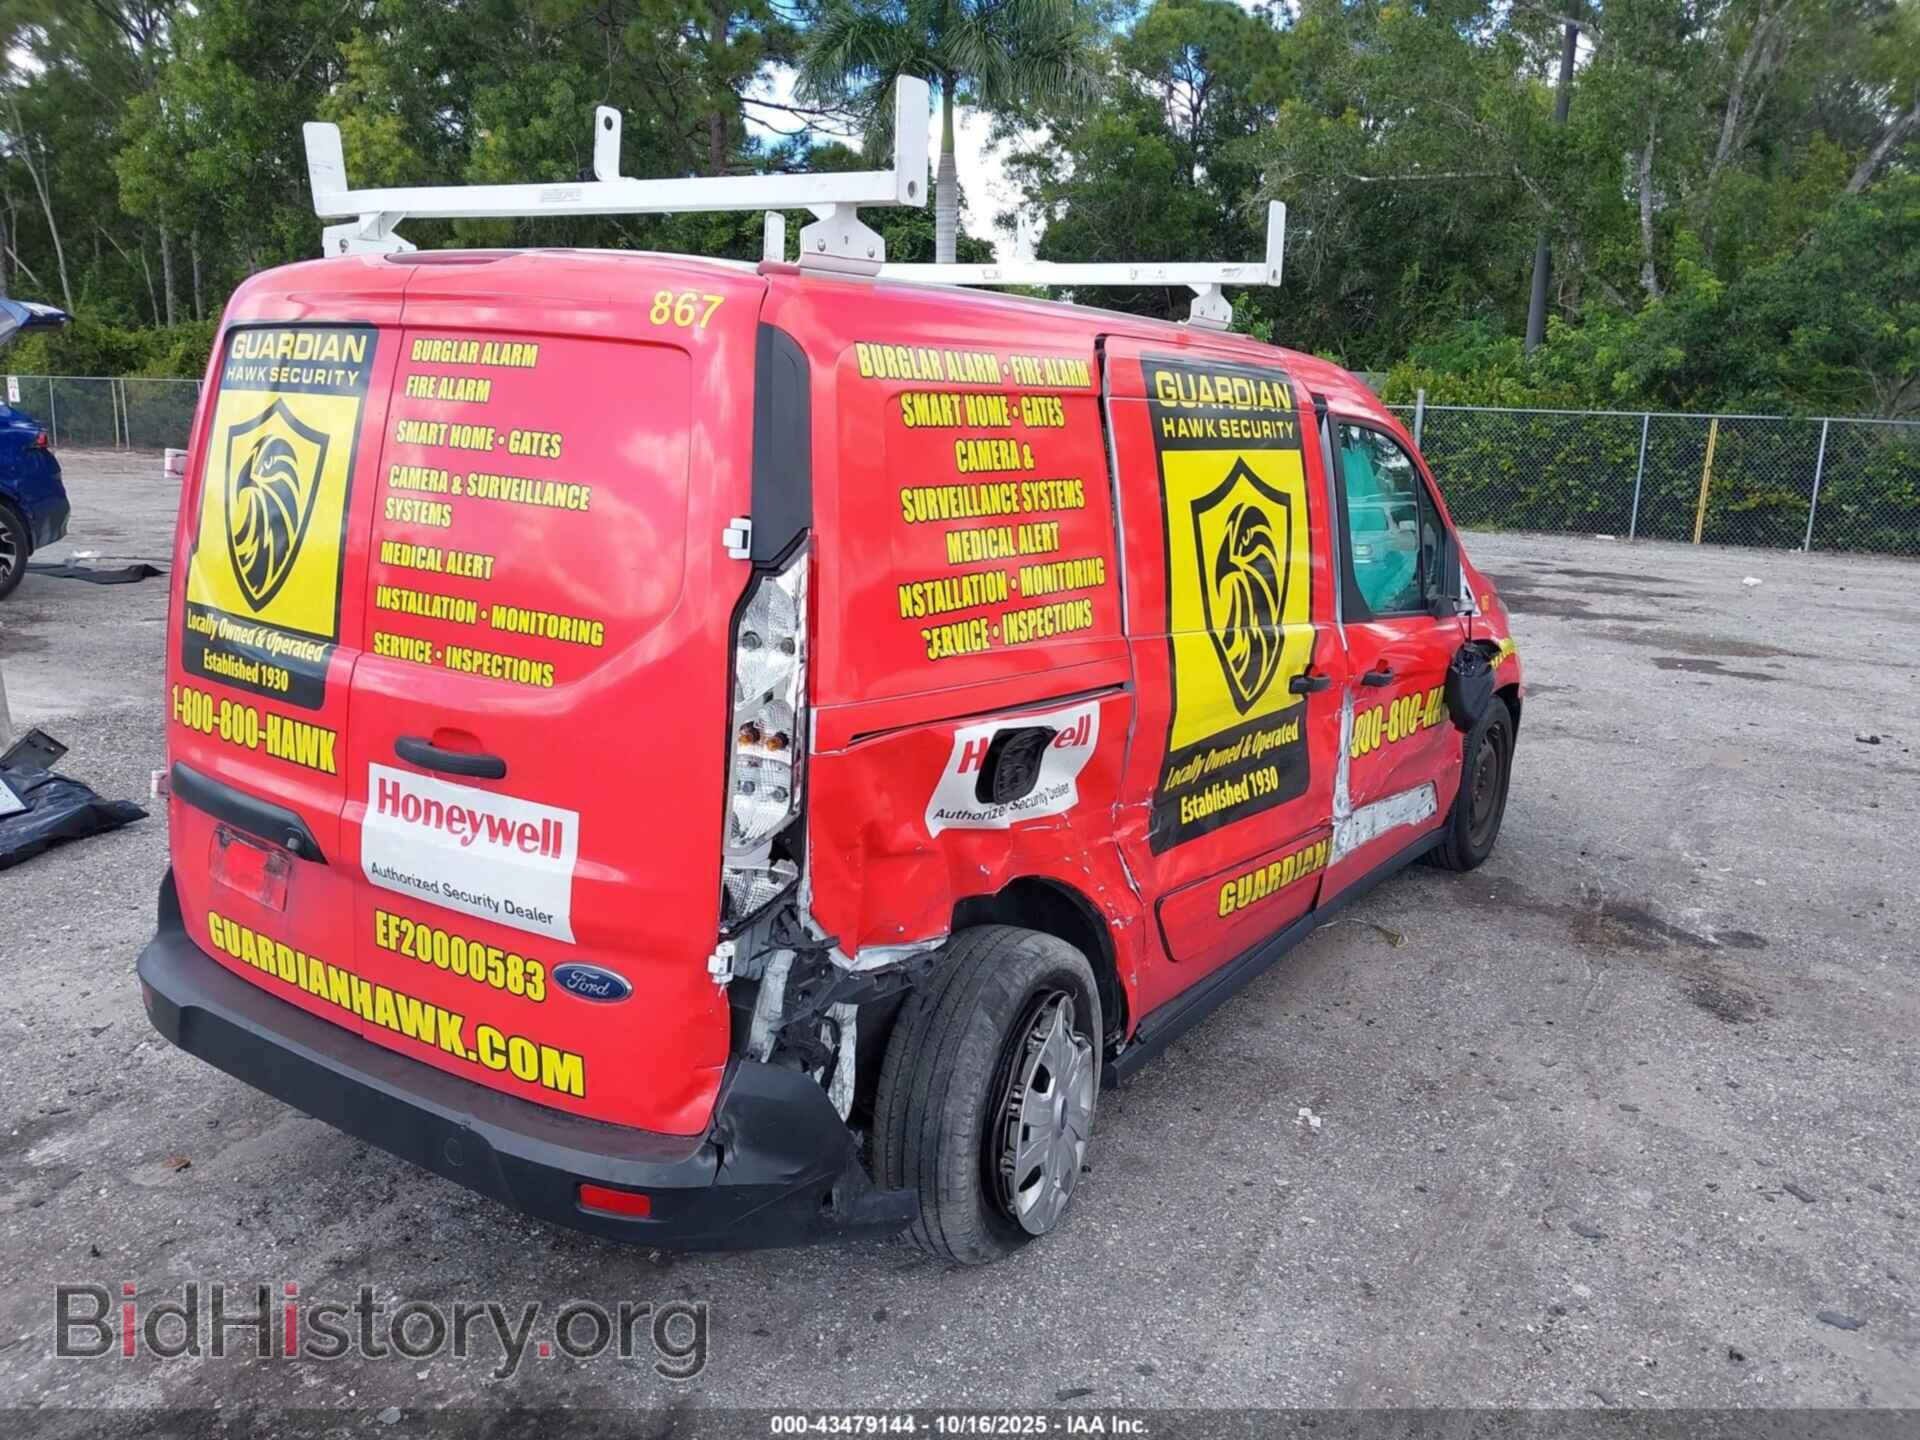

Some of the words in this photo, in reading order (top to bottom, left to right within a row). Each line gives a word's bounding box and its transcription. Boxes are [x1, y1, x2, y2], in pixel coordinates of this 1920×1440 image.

[649, 291, 725, 329] 867
[231, 333, 367, 363] GUARDIAN
[411, 338, 480, 364] BURGLAR
[480, 341, 539, 368] ALARM
[854, 340, 945, 382] BURGLAR
[948, 349, 1002, 384] ALARM
[1010, 353, 1045, 386] FIRE
[1045, 356, 1092, 388] ALARM
[227, 366, 266, 382] HAWK
[269, 367, 360, 387] SECURITY
[405, 375, 435, 399] FIRE
[437, 377, 492, 403] ALARM
[1155, 370, 1292, 413] GUARDIAN
[900, 391, 962, 429] SMART
[963, 393, 1012, 428] HOME
[1020, 395, 1066, 428] GATES
[1162, 417, 1217, 439] HAWK
[1219, 418, 1294, 440] SECURITY
[396, 420, 449, 446] SMART
[449, 423, 495, 451] HOME
[508, 429, 563, 459] GATES
[955, 438, 1021, 474] CAMERA
[1022, 443, 1036, 471] &
[388, 464, 449, 493] CAMERA
[450, 475, 464, 496] &
[466, 472, 592, 511] SURVEILLANCE
[900, 481, 1020, 523] SURVEILLANCE
[1020, 477, 1086, 513] SYSTEMS
[384, 496, 452, 528] SYSTEMS
[380, 540, 443, 573] MEDICAL
[445, 550, 495, 580] ALERT
[945, 526, 1016, 565] MEDICAL
[1018, 521, 1060, 555] ALERT
[1019, 556, 1106, 597] MONITORING
[187, 608, 218, 641] Locally
[218, 617, 255, 646] Owned
[255, 627, 267, 648] &
[266, 632, 329, 663] Operated
[376, 585, 478, 624] INSTALLATION
[490, 603, 604, 647] MONITORING
[1002, 598, 1094, 646] INSPECTIONS
[203, 648, 260, 685] Established
[261, 666, 289, 692] 1930
[373, 631, 433, 664] SERVICE
[445, 645, 554, 688] INSPECTIONS
[172, 683, 338, 776] 1-800-800-HAWK
[1164, 754, 1206, 792] Locally
[1204, 736, 1245, 774] Owned
[1252, 715, 1299, 759] Operated
[1009, 791, 1049, 811] Security
[1180, 773, 1250, 825] Established
[1249, 765, 1279, 797] 1930
[377, 777, 563, 859] Honeywell
[370, 862, 440, 895] Authorized
[442, 884, 500, 913] Security
[503, 900, 554, 925] Dealer
[375, 908, 547, 1003] EF20000583
[206, 910, 587, 1098] GUARDIANHAWK.COM
[565, 970, 610, 997] Ford
